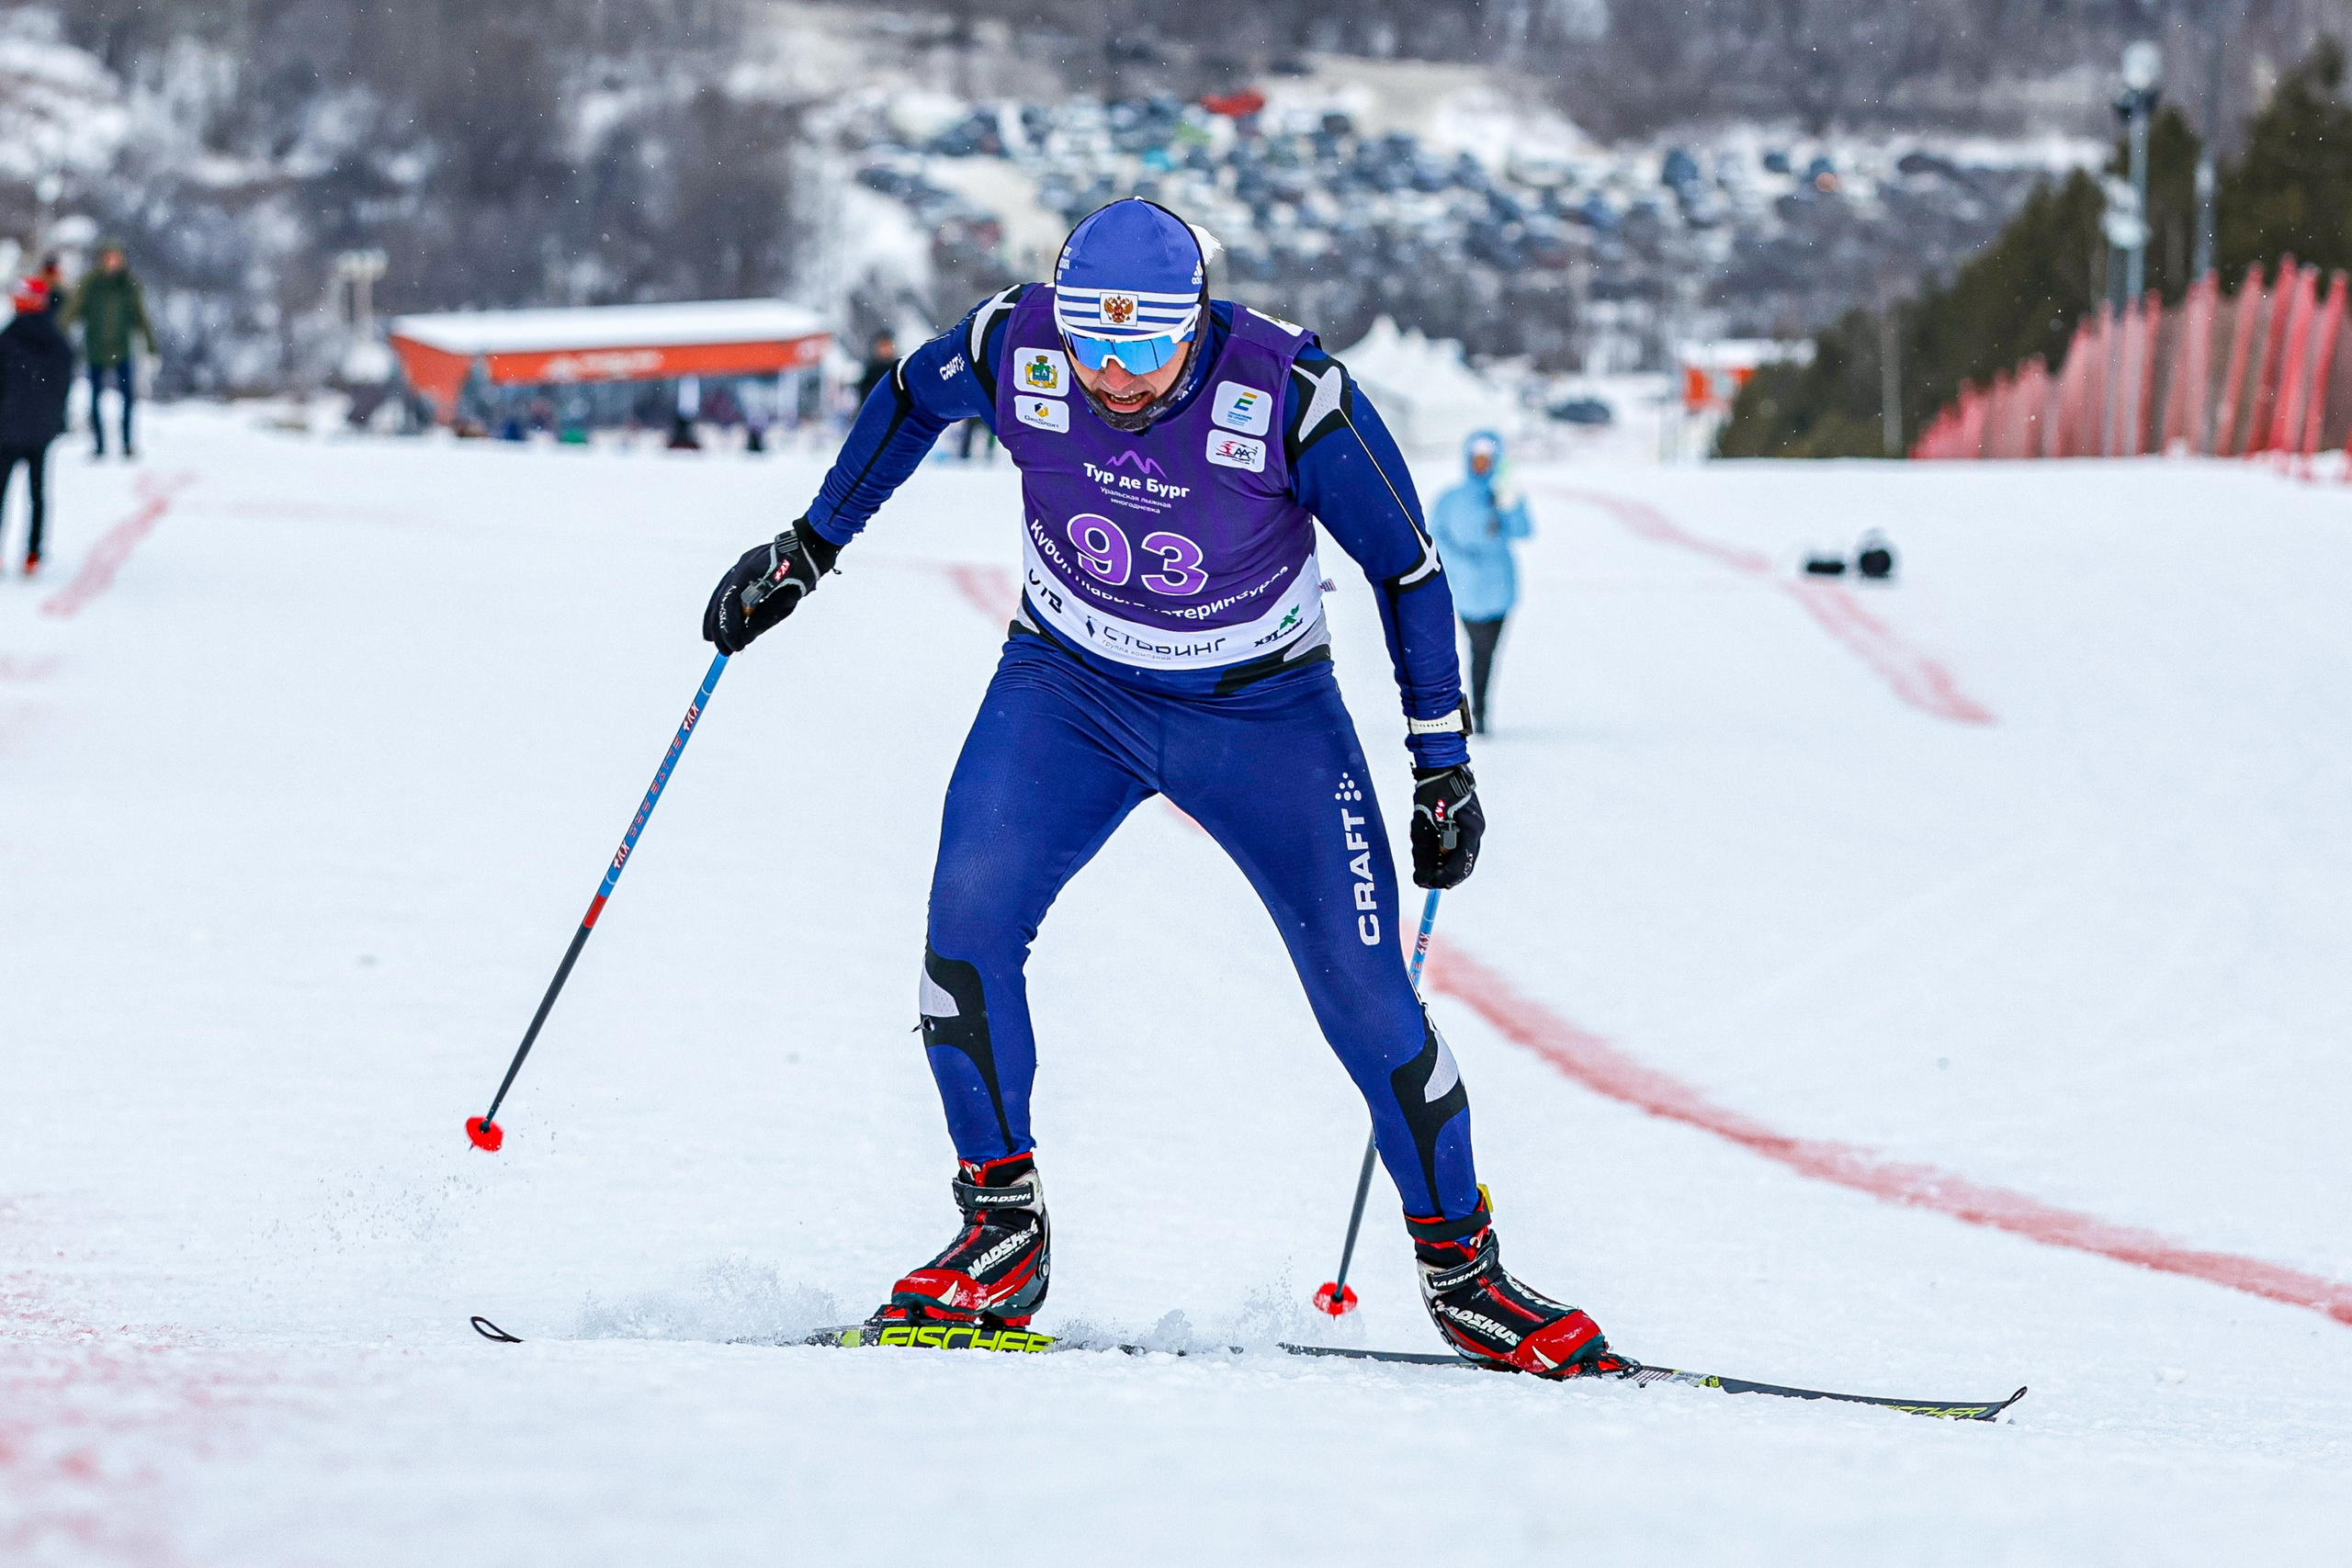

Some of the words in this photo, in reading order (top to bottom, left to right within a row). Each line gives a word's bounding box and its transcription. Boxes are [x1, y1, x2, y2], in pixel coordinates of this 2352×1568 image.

[1083, 462, 1115, 485] Тур
[1118, 475, 1141, 490] де
[1146, 478, 1191, 499] Бург
[1100, 486, 1140, 502] Уральская
[1140, 497, 1172, 509] лыжная
[1110, 497, 1161, 514] многодневка
[1067, 513, 1209, 596] 93
[1102, 638, 1129, 654] группа
[1340, 808, 1380, 946] CRAFT
